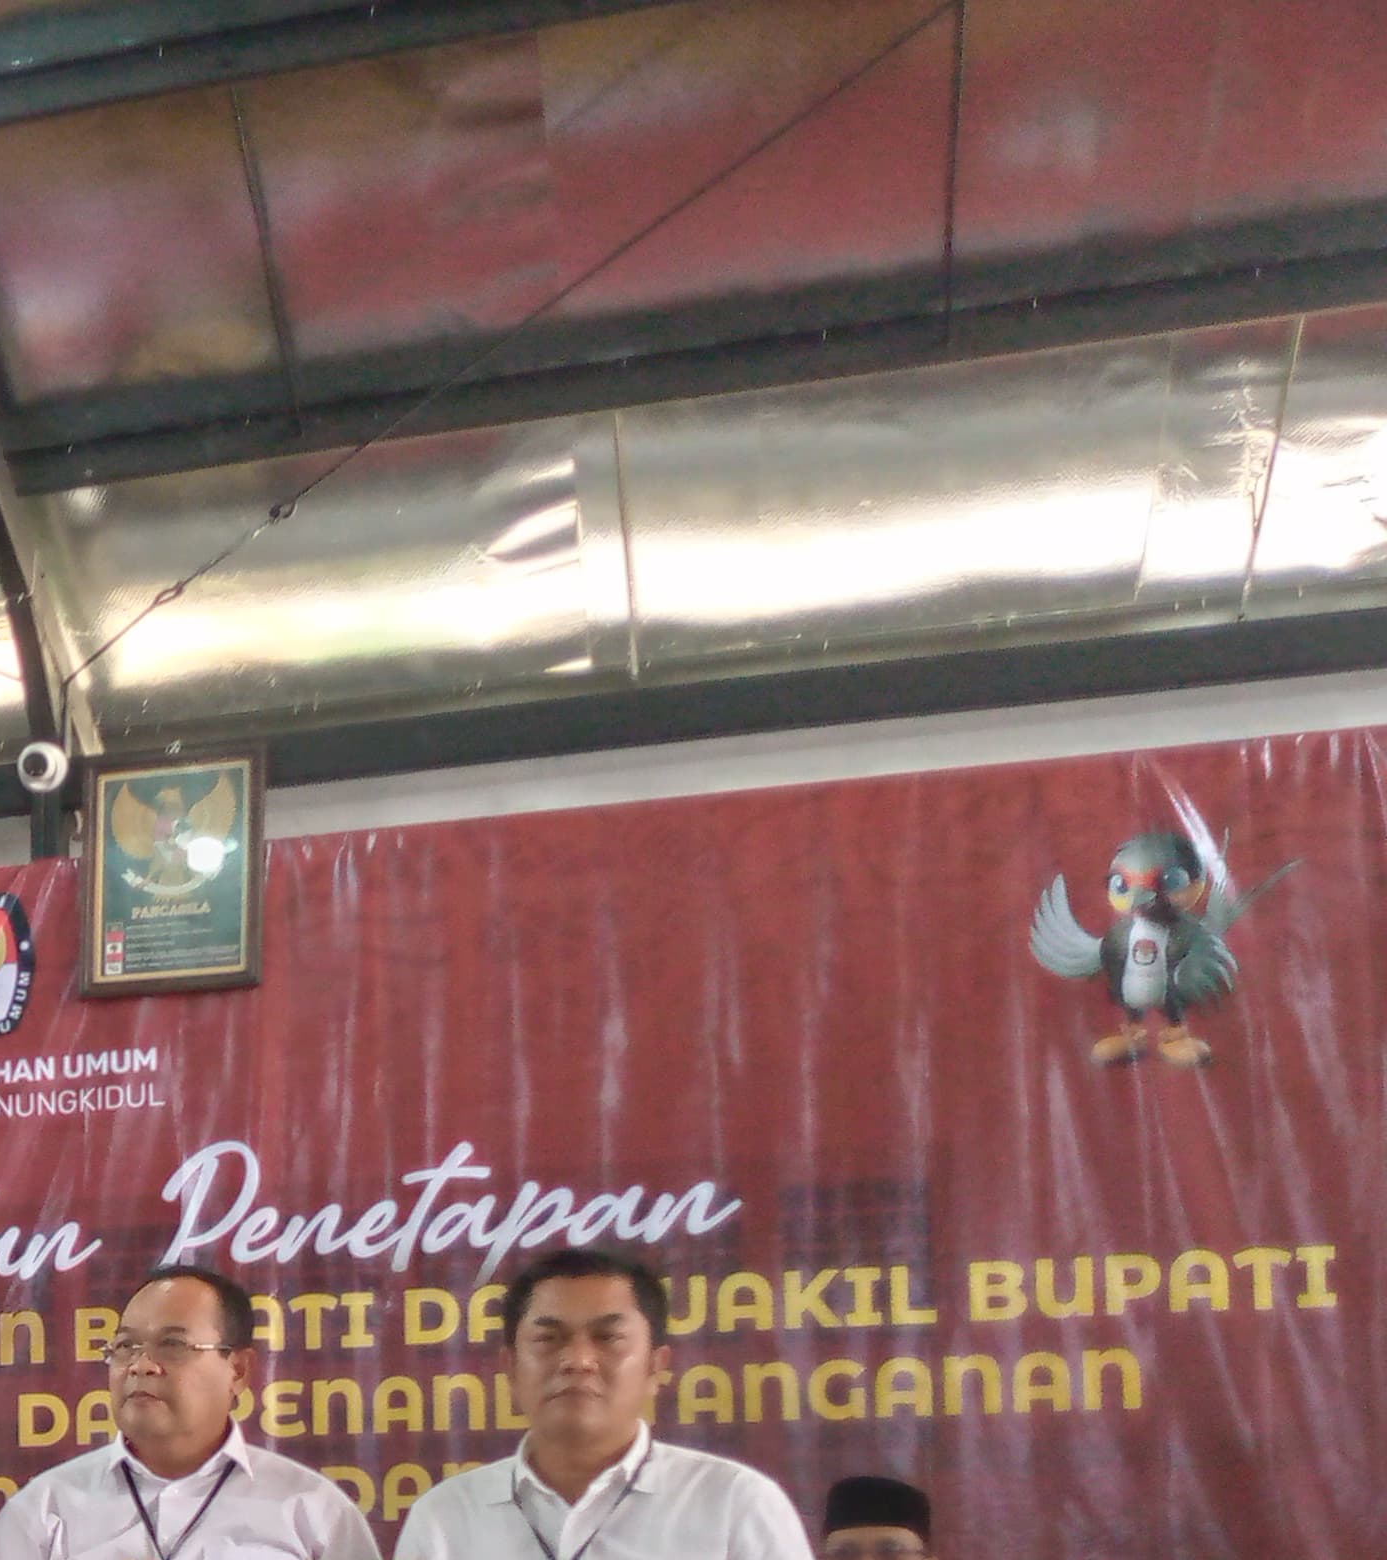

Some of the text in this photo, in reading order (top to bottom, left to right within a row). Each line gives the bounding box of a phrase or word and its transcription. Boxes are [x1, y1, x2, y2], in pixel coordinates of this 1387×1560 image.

[0, 972, 31, 1033] UMUM
[62, 1047, 157, 1079] UMUM
[161, 1140, 742, 1284] Penetapan
[404, 1284, 508, 1345] DA
[969, 1245, 1337, 1323] BUPATI
[18, 1389, 118, 1448] DA
